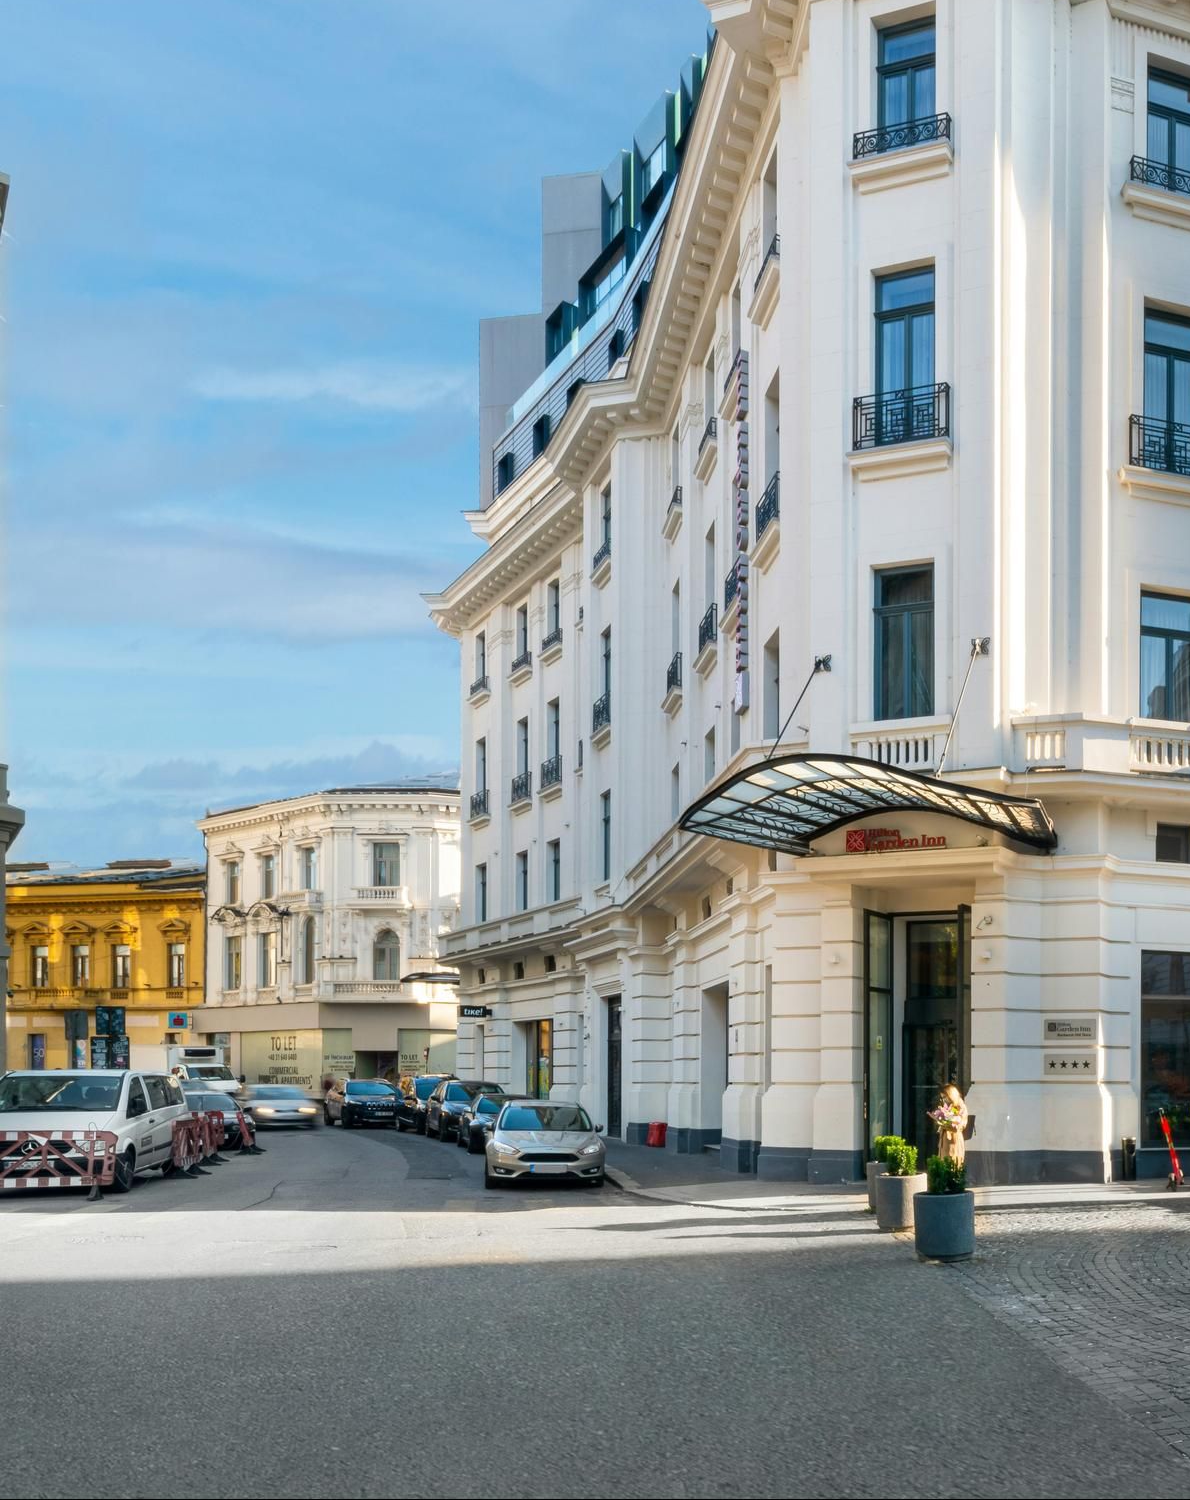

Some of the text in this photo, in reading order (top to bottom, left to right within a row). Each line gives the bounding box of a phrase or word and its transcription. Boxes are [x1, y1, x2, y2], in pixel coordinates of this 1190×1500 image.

[921, 834, 947, 847] Inn
[271, 1036, 297, 1051] TO LET
